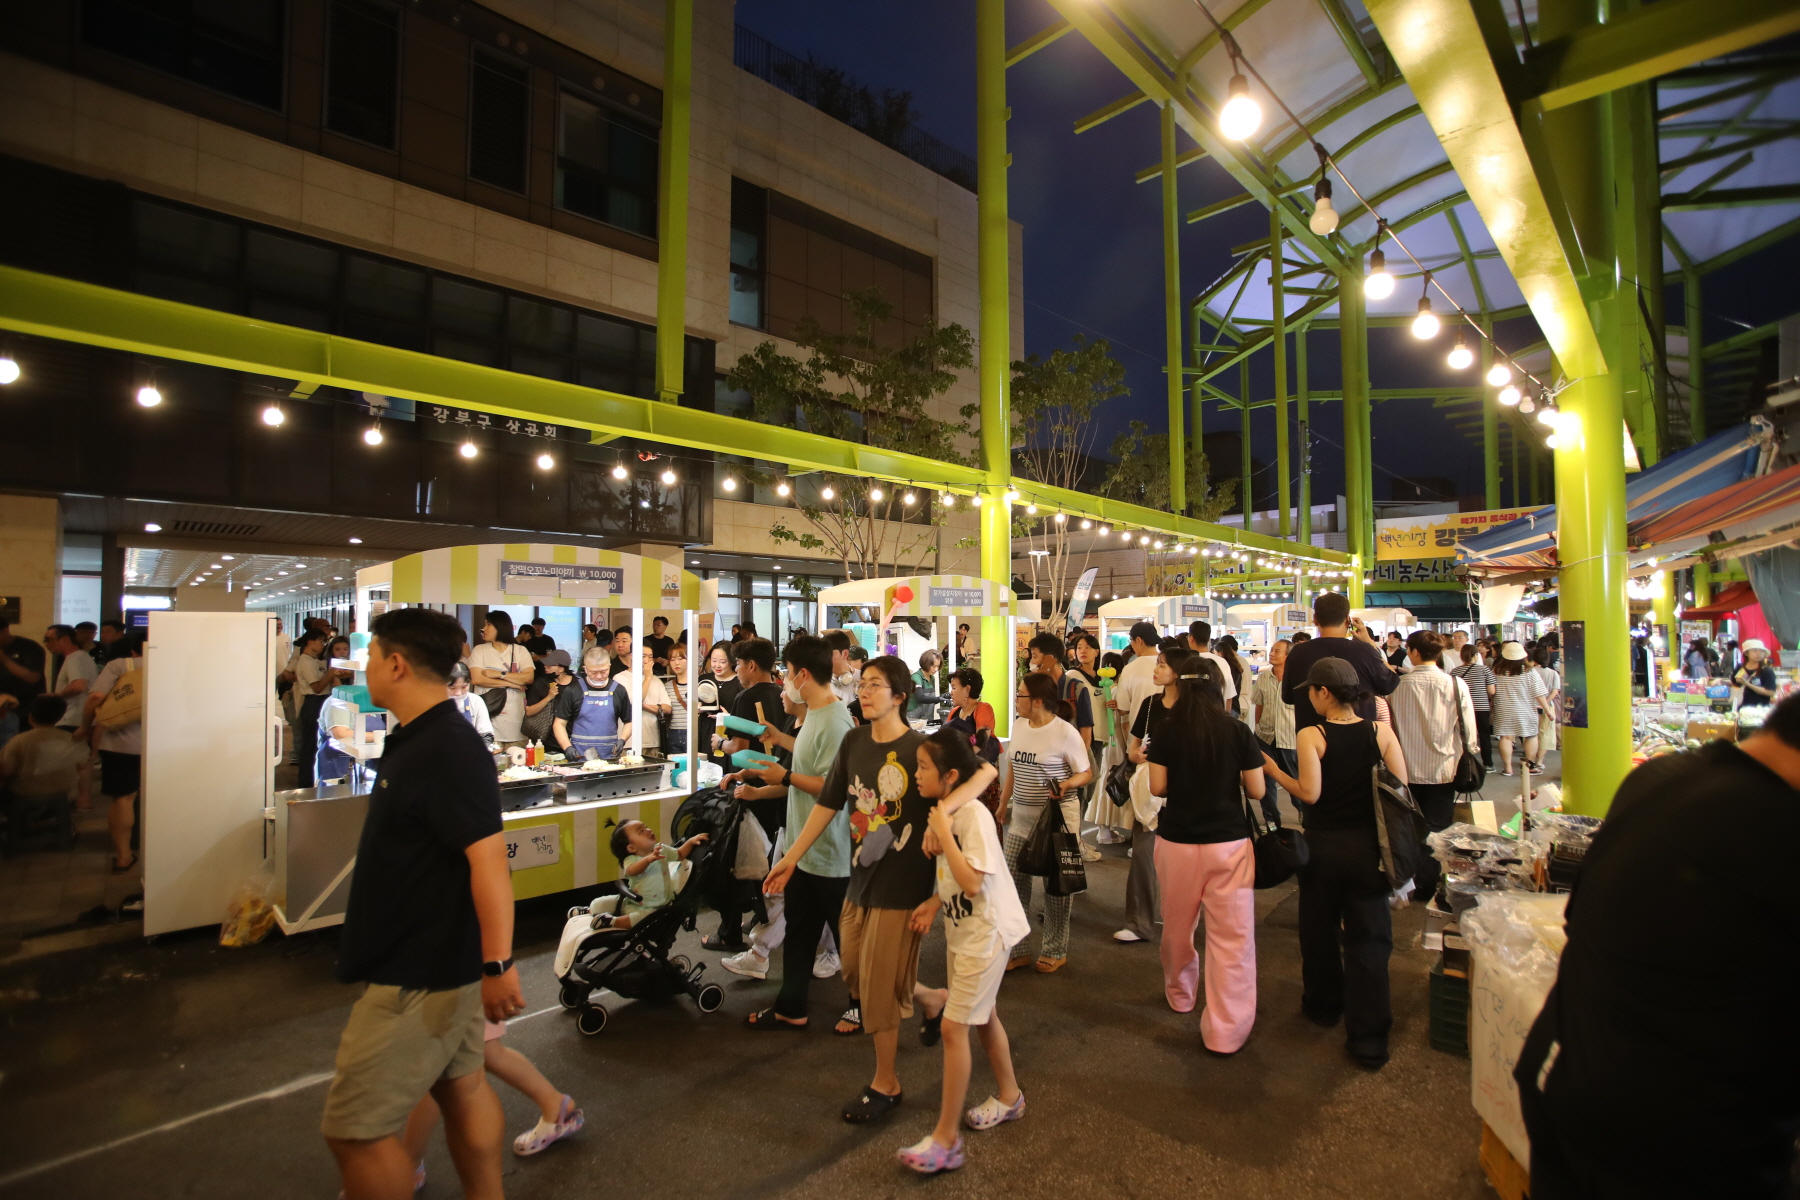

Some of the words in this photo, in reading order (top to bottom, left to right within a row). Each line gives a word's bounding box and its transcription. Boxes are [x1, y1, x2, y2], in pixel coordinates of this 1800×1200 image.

[433, 406, 491, 430] 강북구
[505, 419, 557, 438] 상공회
[590, 570, 617, 579] 10,000
[114, 689, 135, 702] EARTH
[1014, 750, 1038, 765] COOL
